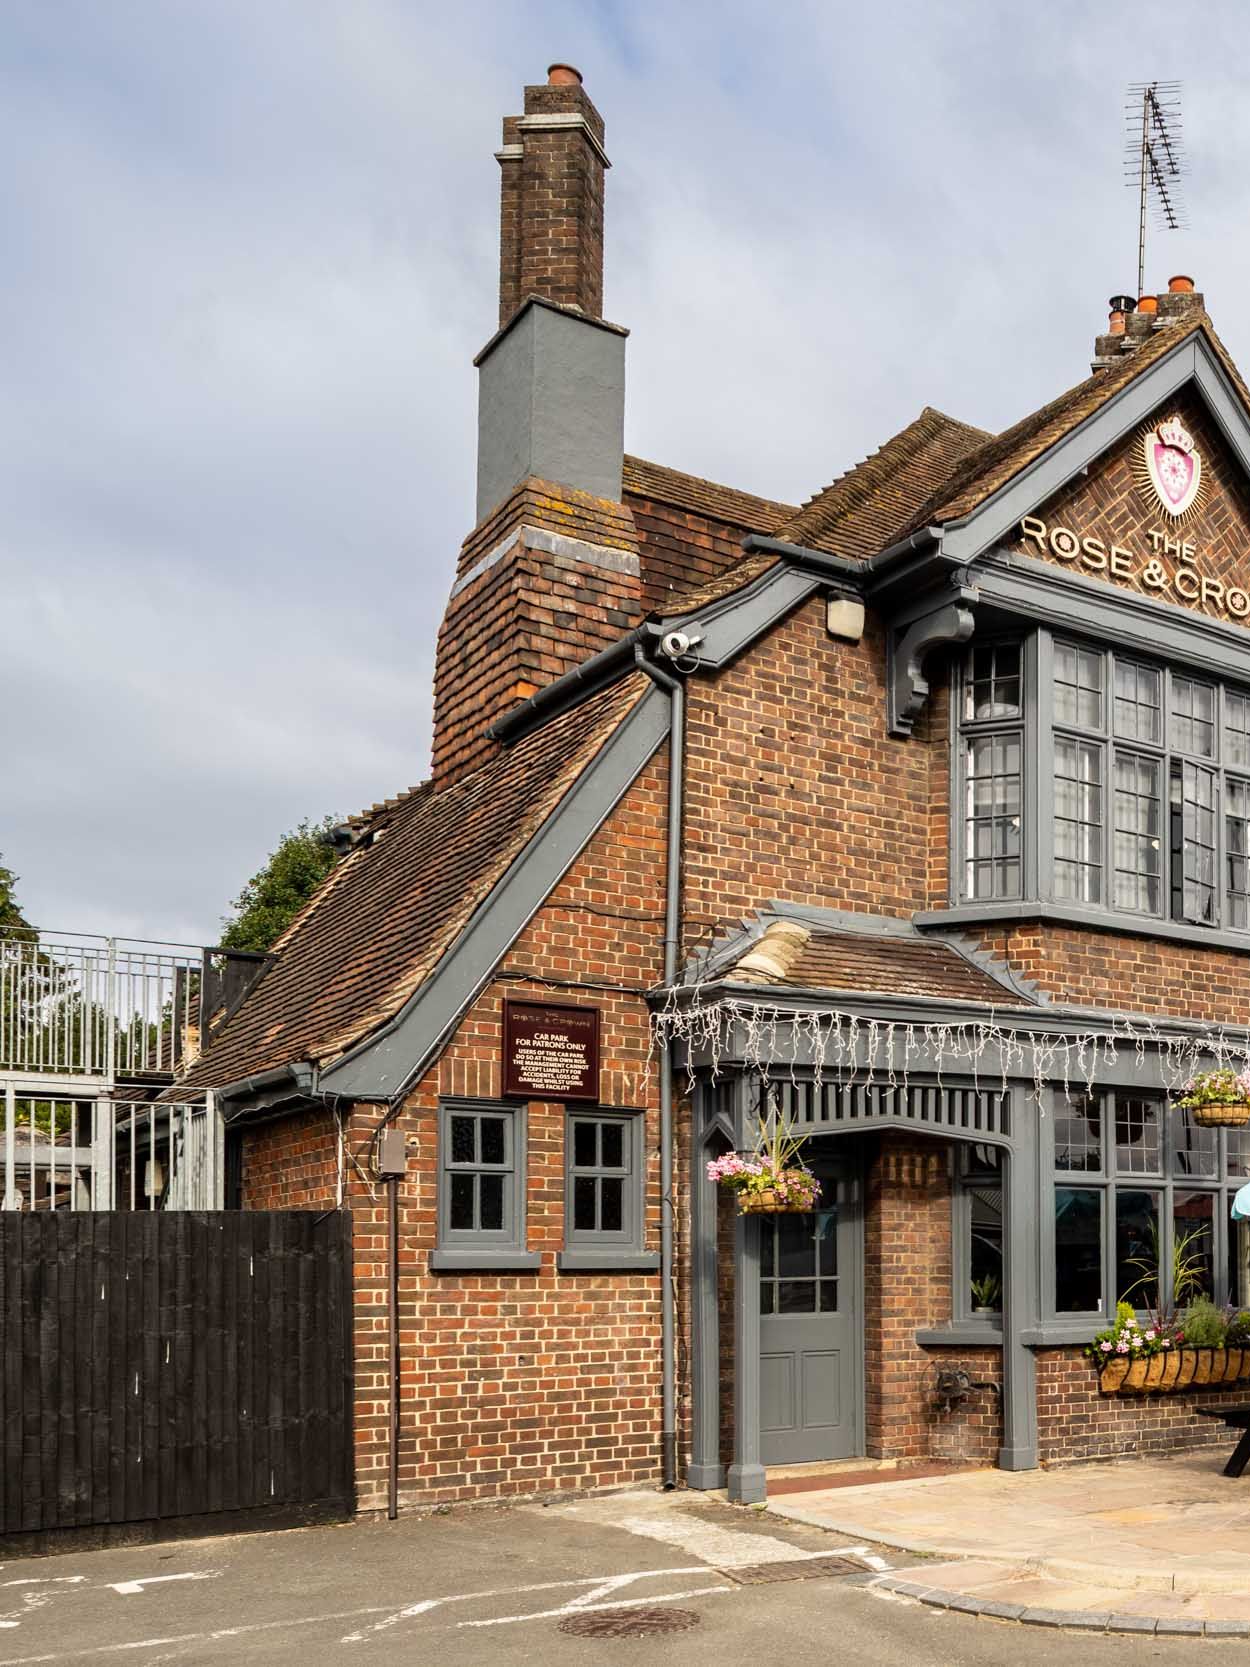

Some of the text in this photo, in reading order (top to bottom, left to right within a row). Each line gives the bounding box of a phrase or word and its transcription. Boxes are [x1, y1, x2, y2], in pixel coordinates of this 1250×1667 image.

[1147, 528, 1198, 562] THE
[1020, 516, 1134, 578] ROSE
[1143, 559, 1167, 588] &
[534, 1032, 569, 1042] CAR PARK
[515, 1038, 586, 1050] FOR PATRONS ONLY
[524, 1060, 565, 1068] MANAGEMENT
